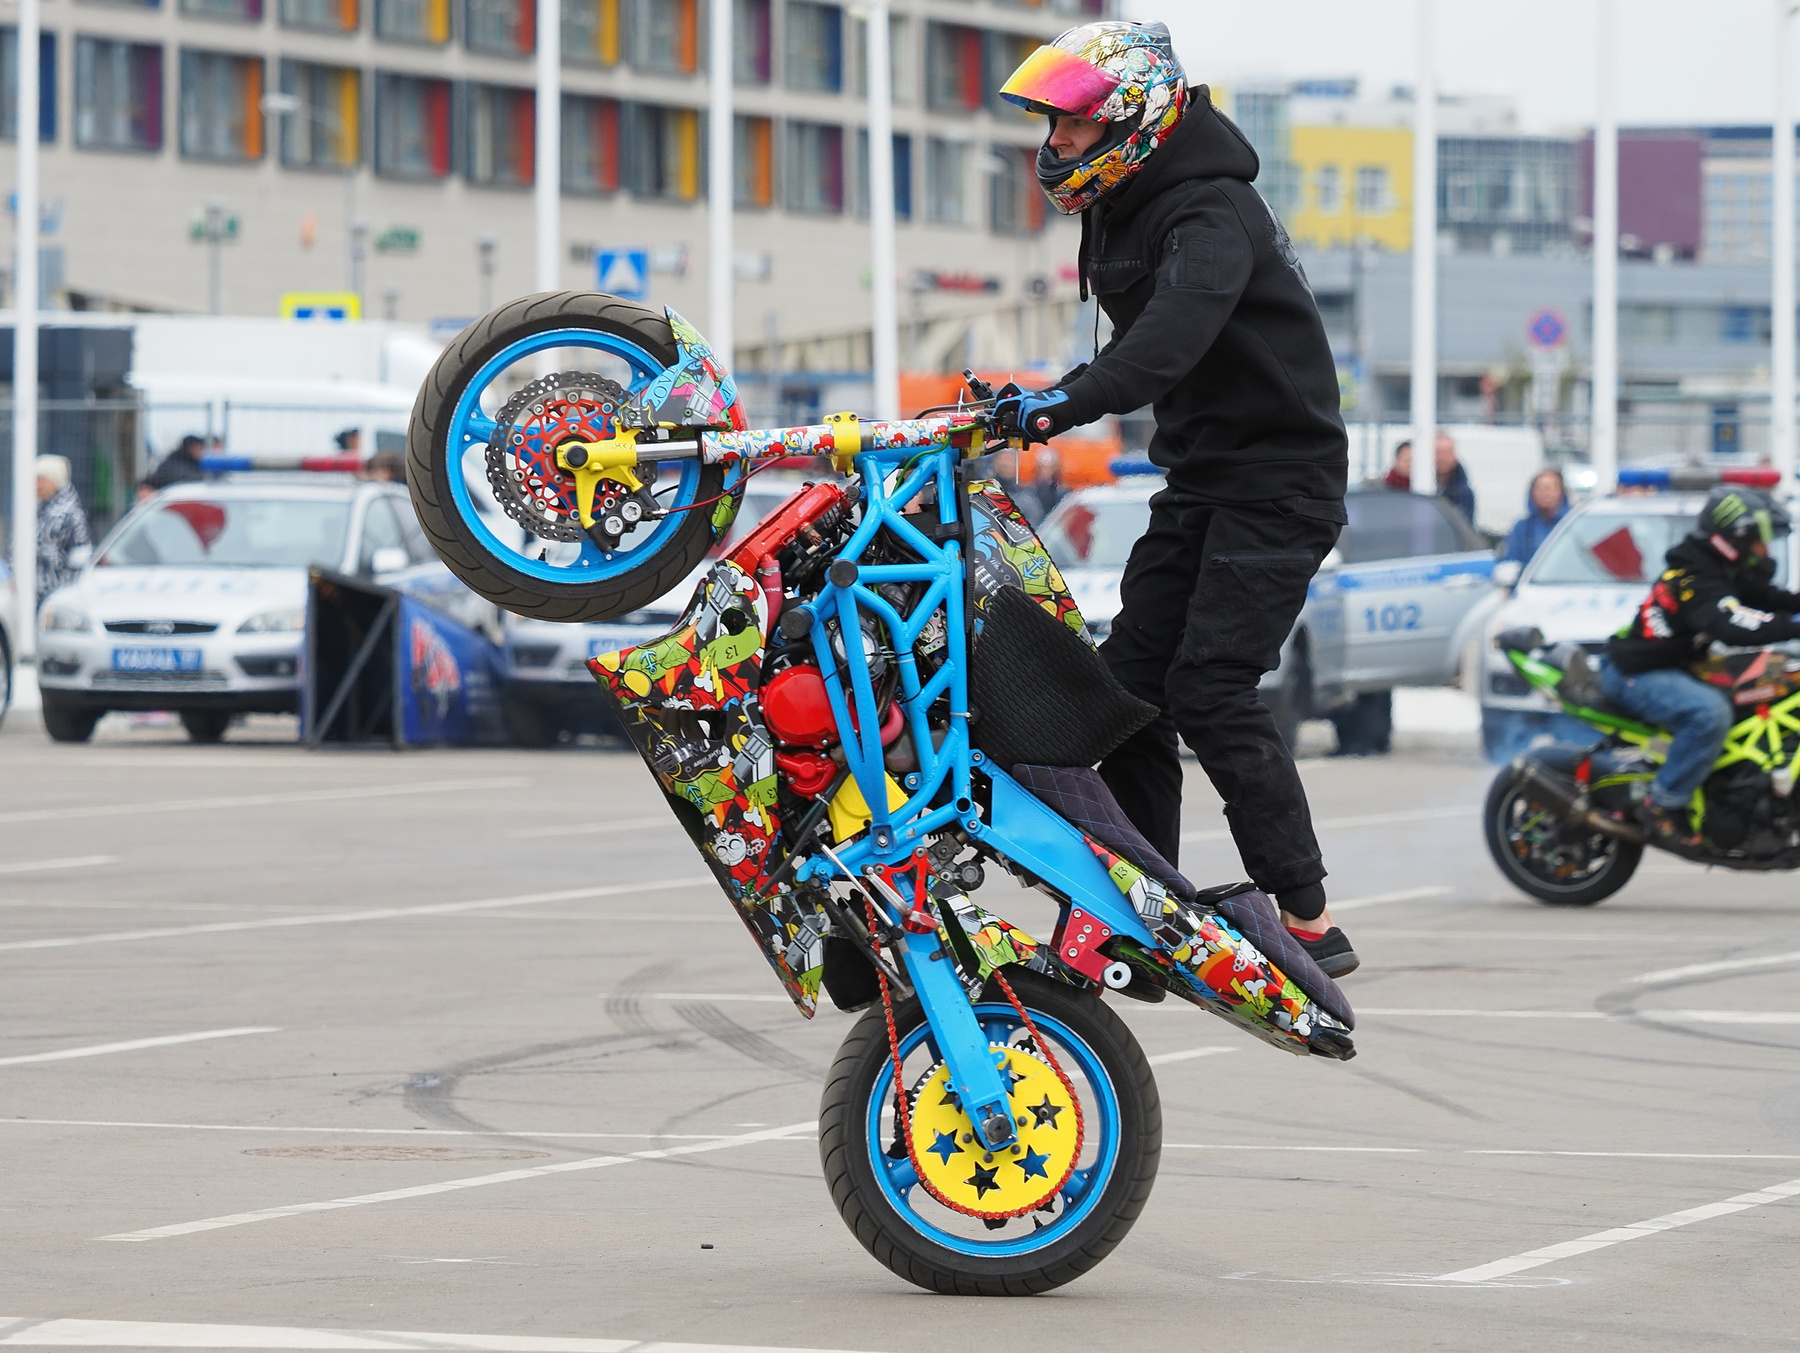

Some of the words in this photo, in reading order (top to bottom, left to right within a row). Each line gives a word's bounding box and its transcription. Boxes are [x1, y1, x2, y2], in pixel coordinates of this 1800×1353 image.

[1365, 602, 1423, 632] 102
[725, 644, 739, 660] 13
[1114, 866, 1129, 880] 13
